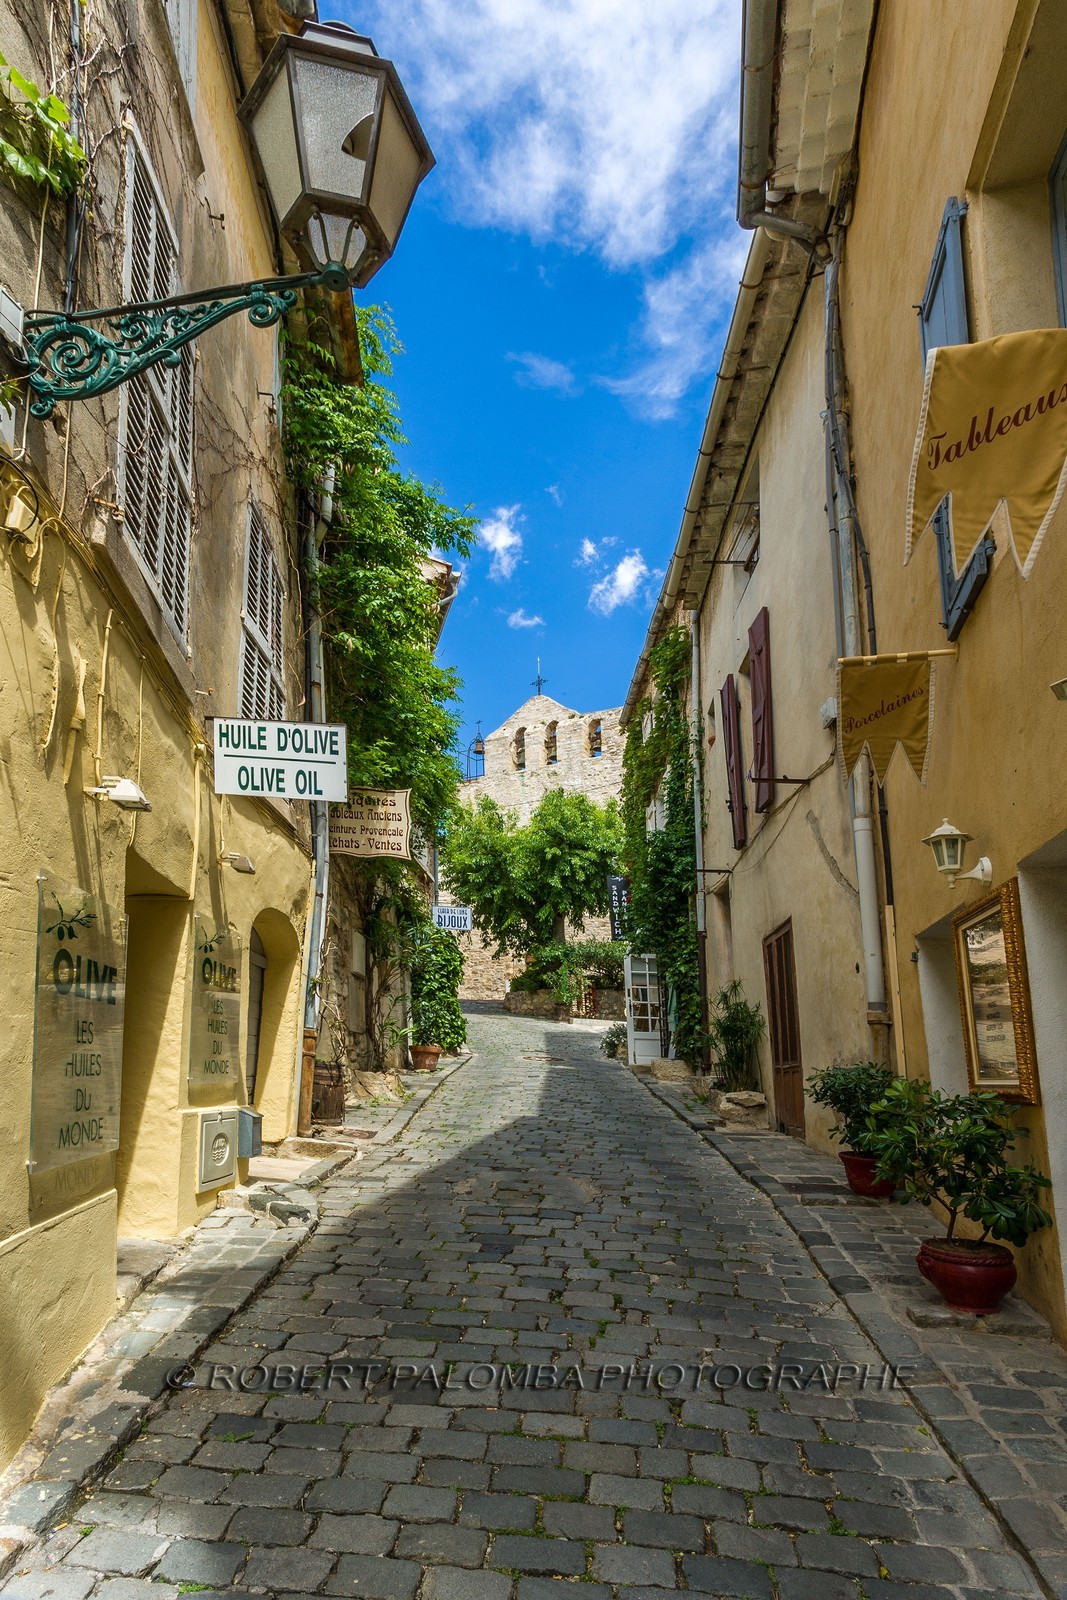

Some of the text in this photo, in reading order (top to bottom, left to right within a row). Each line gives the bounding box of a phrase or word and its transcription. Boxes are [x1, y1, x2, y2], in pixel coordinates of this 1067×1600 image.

[844, 686, 925, 735] Porcelaines
[218, 723, 340, 756] HUILE D'OLIVE
[237, 765, 323, 796] OLIVE OIL
[328, 806, 402, 822] ableaux Anciens
[328, 823, 404, 839] einture Provençale
[367, 837, 402, 851] Ventes
[437, 914, 468, 929] BIJOUX
[611, 884, 622, 935] SANDWICH
[53, 948, 117, 1006] OLIVE
[201, 956, 237, 992] OLIVE
[213, 999, 224, 1015] LES
[76, 1019, 94, 1045] LES
[207, 1017, 228, 1036] HUILES
[212, 1040, 223, 1055] DU
[65, 1052, 102, 1077] HUILES
[203, 1058, 230, 1075] MONDE
[75, 1087, 92, 1112] DU
[58, 1117, 104, 1150] MONDE
